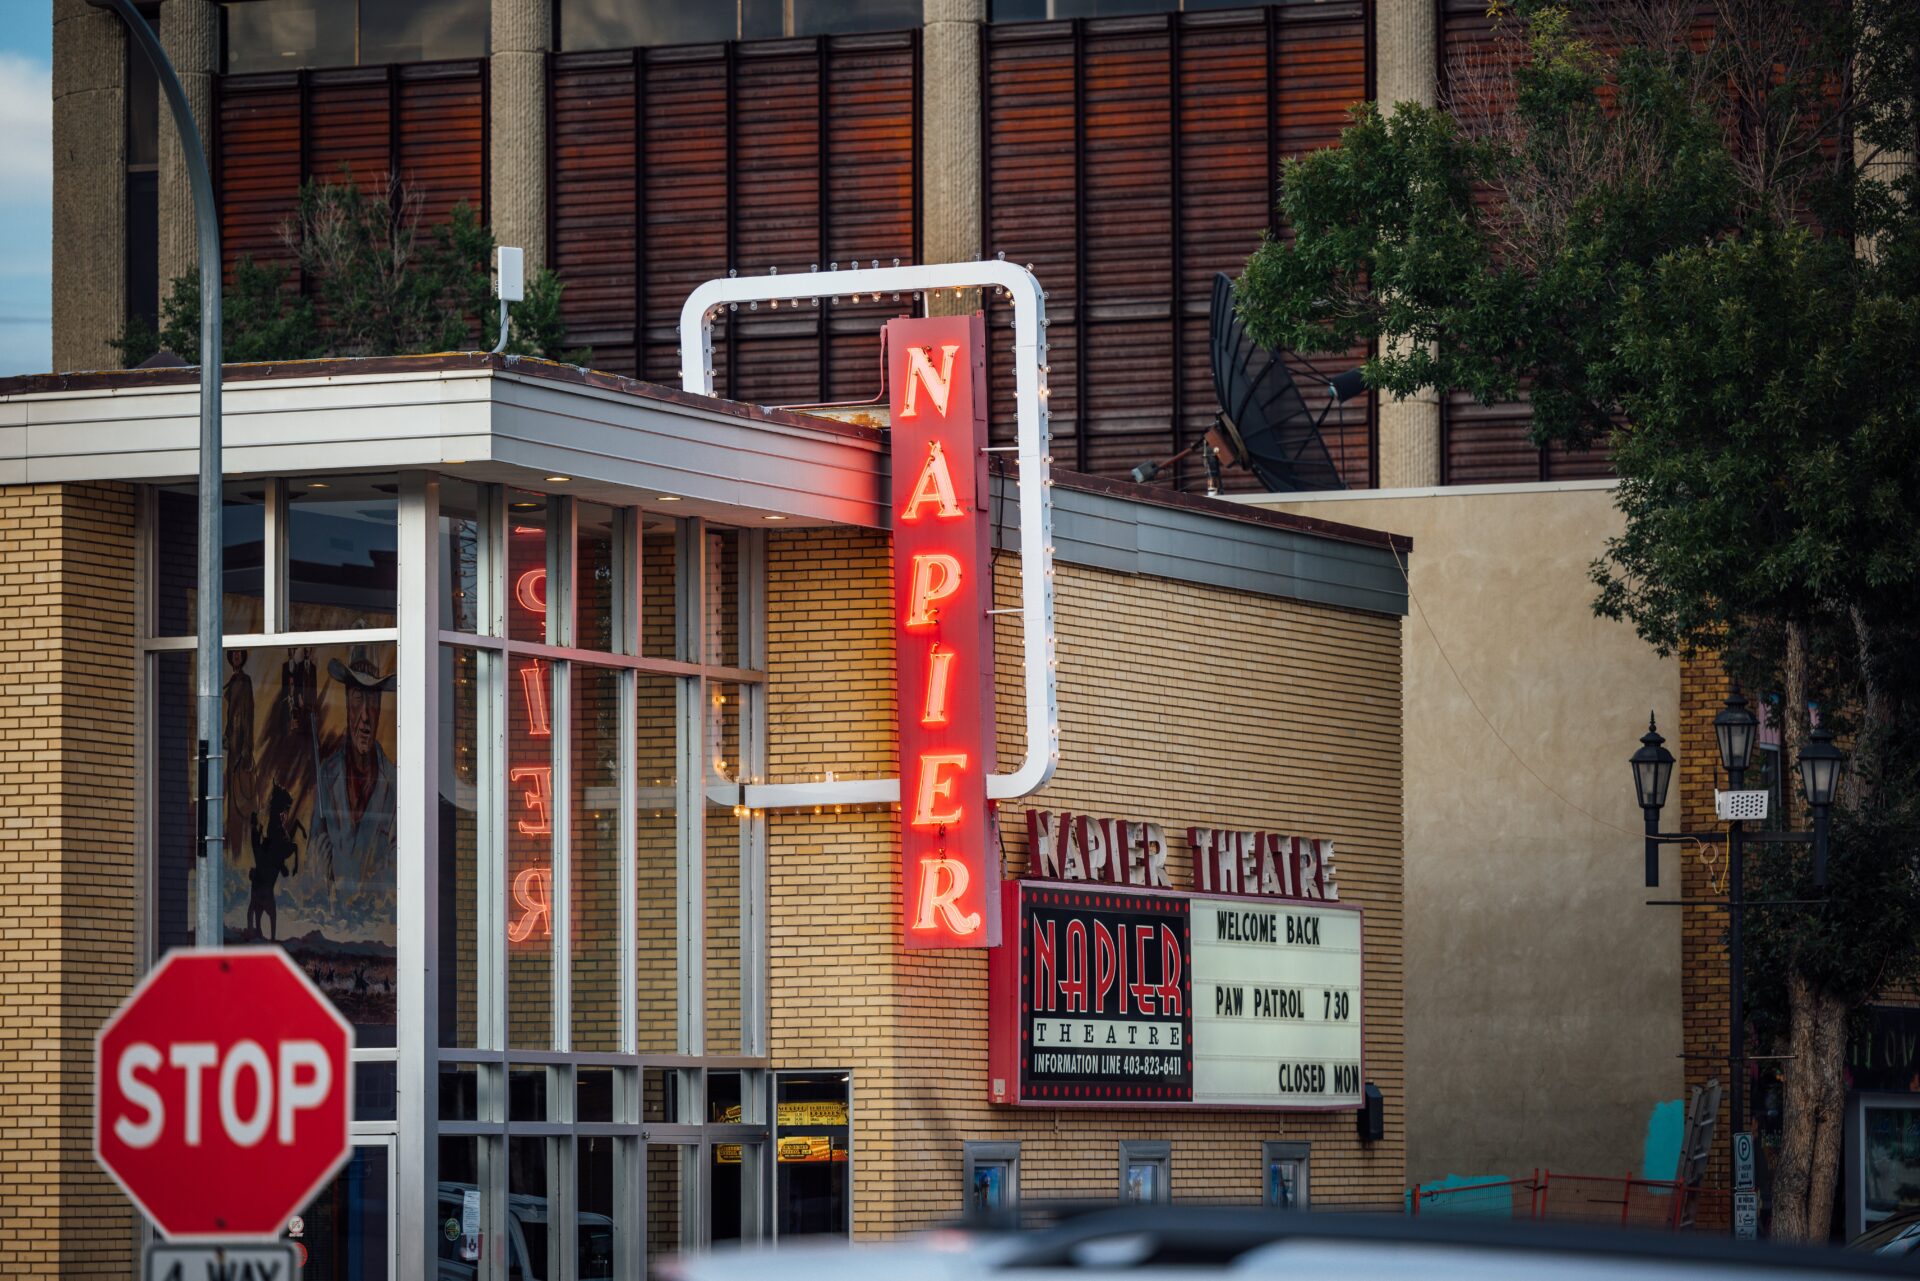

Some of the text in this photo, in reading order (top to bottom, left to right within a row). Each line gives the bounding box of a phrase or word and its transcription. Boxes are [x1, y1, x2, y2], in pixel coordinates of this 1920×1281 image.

[900, 343, 981, 936] NAPIER
[1026, 809, 1339, 902] NAPIER THEATRE
[1217, 910, 1320, 945] WELCOME BACK
[1033, 912, 1183, 1017] NAPIER
[1216, 986, 1243, 1016] PAW
[1254, 988, 1305, 1019] PATROL
[1036, 1023, 1180, 1046] THEATRE
[1034, 1053, 1182, 1076] INFORMATION LINE 403-823-6411
[1279, 1064, 1360, 1094] CLOSED MON
[114, 1040, 333, 1149] STOP
